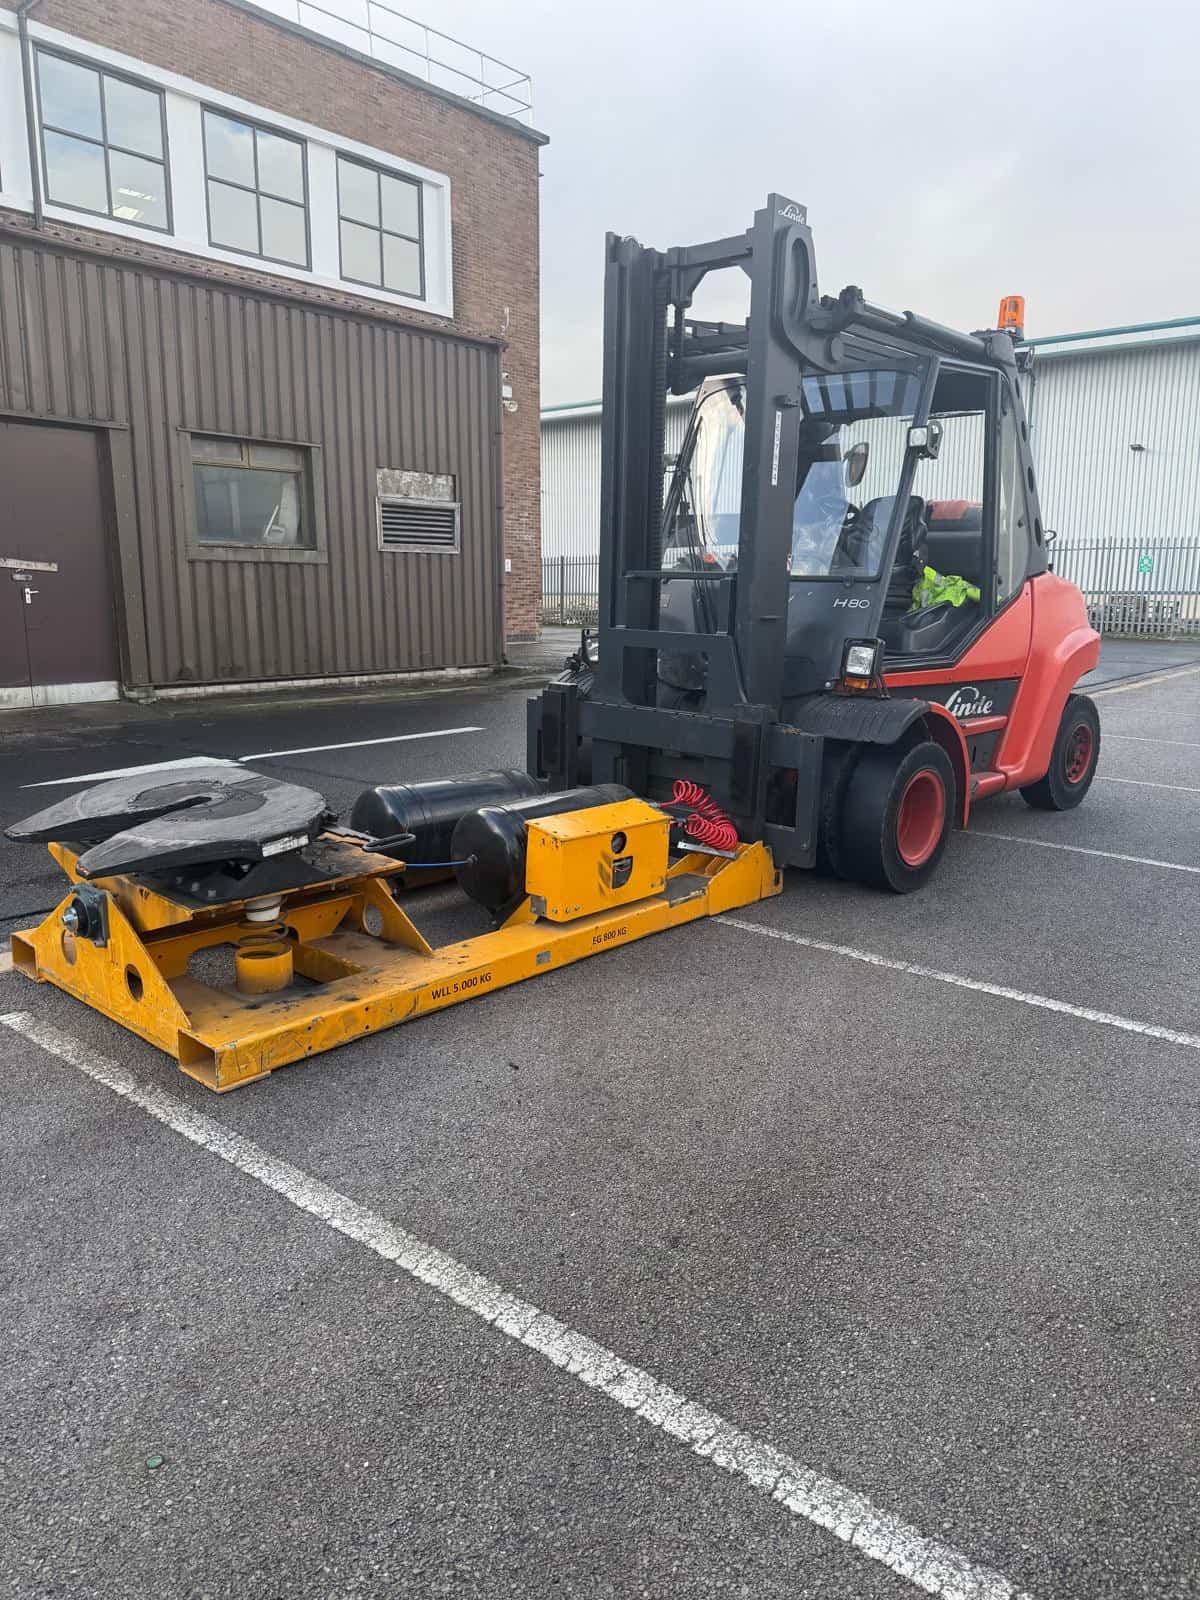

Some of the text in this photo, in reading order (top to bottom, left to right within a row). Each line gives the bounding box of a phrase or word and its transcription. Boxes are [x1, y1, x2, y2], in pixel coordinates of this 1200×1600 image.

[778, 203, 805, 223] Linde
[944, 686, 993, 717] Linde
[592, 926, 627, 945] EG 800 KG
[431, 972, 493, 1001] WLL 5.000 KG
